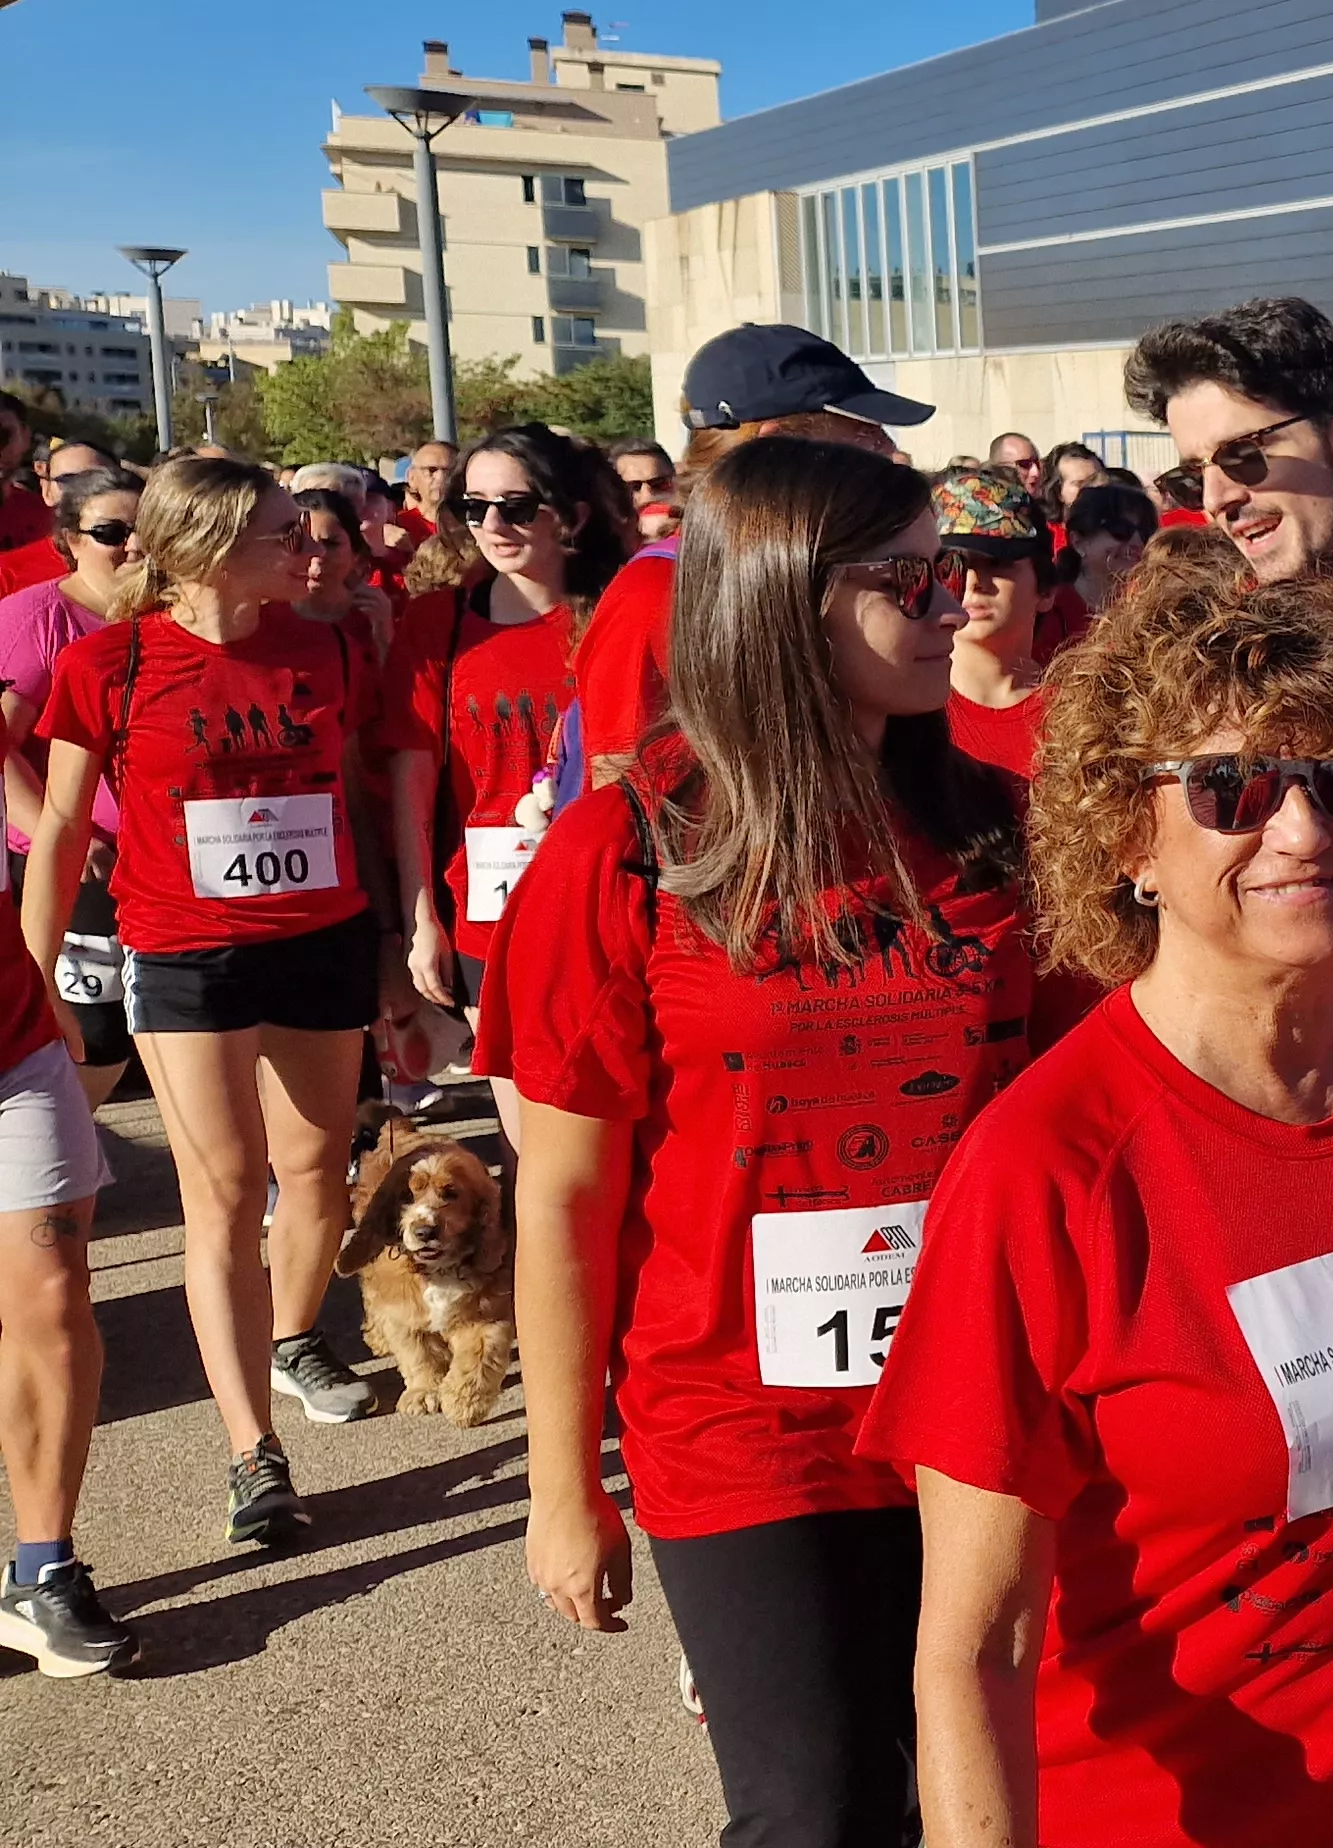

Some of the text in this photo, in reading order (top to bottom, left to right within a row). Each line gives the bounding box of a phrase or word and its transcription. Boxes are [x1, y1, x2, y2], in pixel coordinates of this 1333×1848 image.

[223, 849, 309, 887] 400
[787, 998, 861, 1015] MARCHA
[864, 988, 951, 1009] SOLIDARIA
[790, 1020, 814, 1032] POR
[816, 1019, 835, 1031] LA
[836, 1013, 909, 1030] ESCLEROSIS
[864, 1252, 906, 1263] AODEM
[772, 1275, 814, 1294] MARCHA
[815, 1273, 867, 1292] SOLIDARIA
[868, 1269, 888, 1288] POR
[890, 1268, 902, 1285] LA
[816, 1304, 904, 1372] 15
[1279, 1352, 1331, 1386] MARCHA
